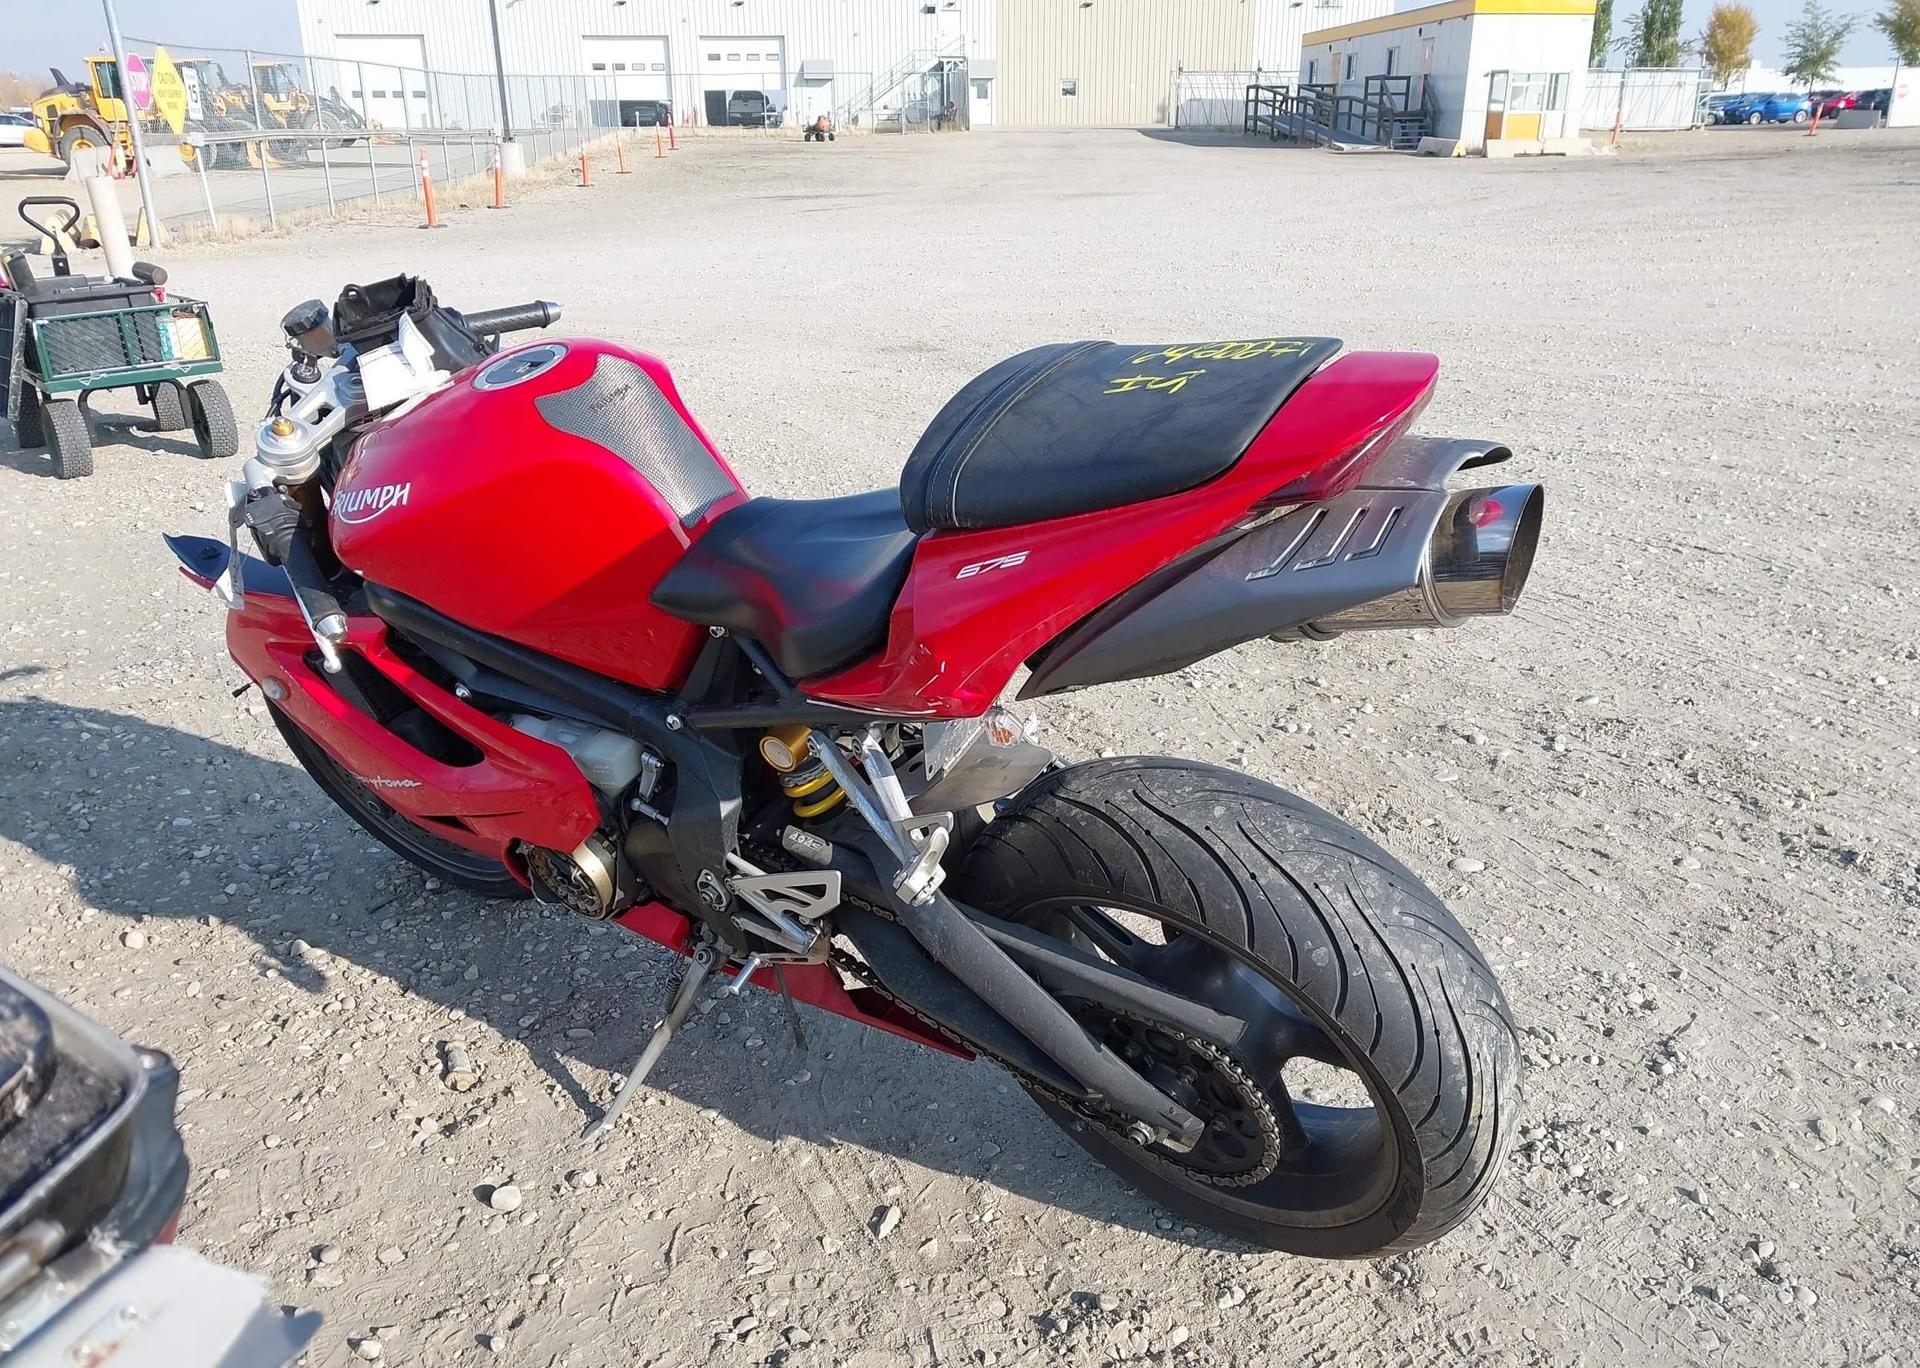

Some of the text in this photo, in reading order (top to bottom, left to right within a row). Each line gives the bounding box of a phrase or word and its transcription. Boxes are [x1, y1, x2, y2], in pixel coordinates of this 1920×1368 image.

[129, 71, 149, 92] STOP
[188, 84, 200, 104] 15
[955, 550, 1030, 580] 675
